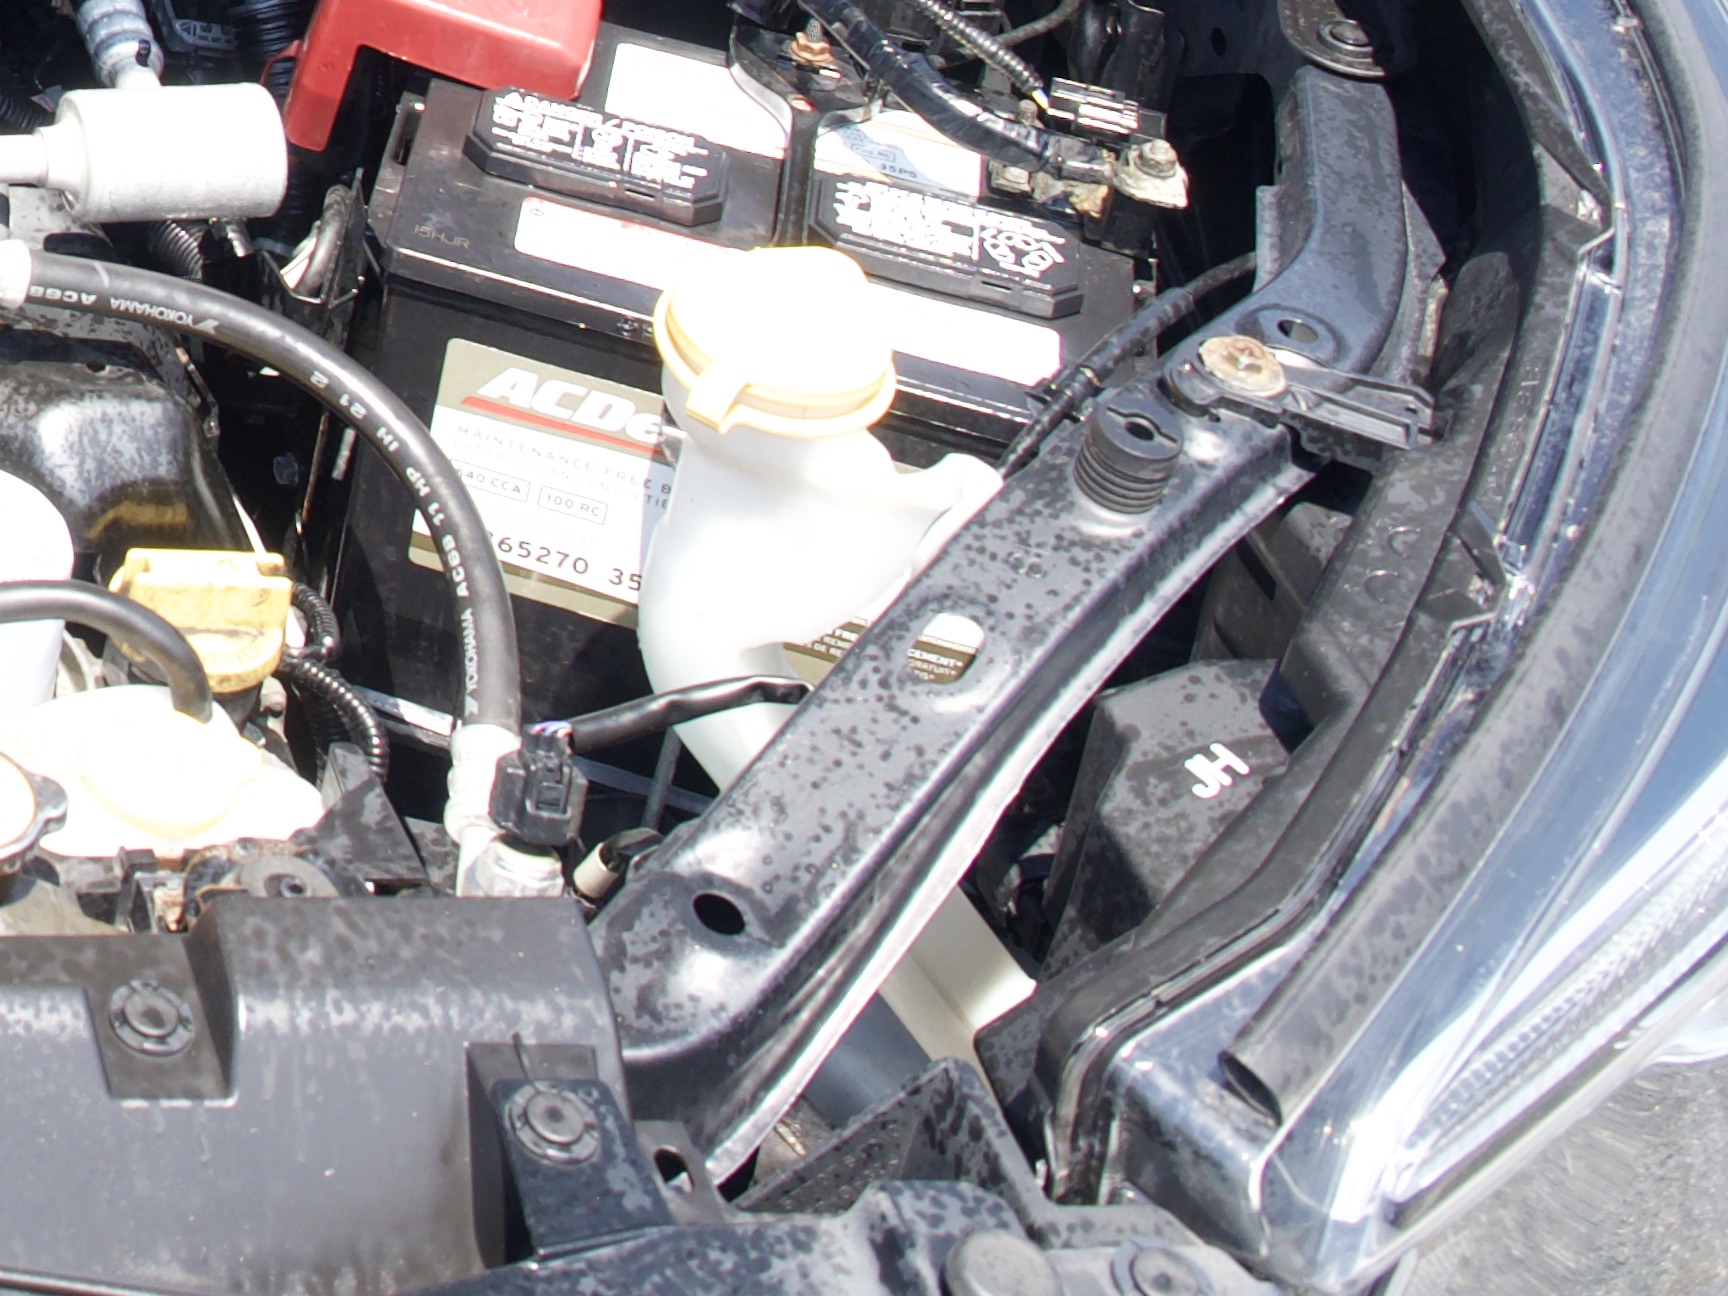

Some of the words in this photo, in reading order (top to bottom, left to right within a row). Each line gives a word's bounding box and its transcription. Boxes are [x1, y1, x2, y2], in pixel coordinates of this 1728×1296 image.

[109, 296, 196, 327] YOKOHAMA
[475, 366, 664, 444] ACDe
[457, 425, 594, 472] MAINTENANCE
[603, 466, 651, 489] FREE
[405, 466, 430, 498] HP
[490, 477, 522, 495] CCA
[546, 493, 575, 510] 100
[579, 501, 600, 518] RC
[489, 529, 590, 576] 65270
[456, 608, 480, 694] YOKOHAMA
[1184, 742, 1250, 799] JH
